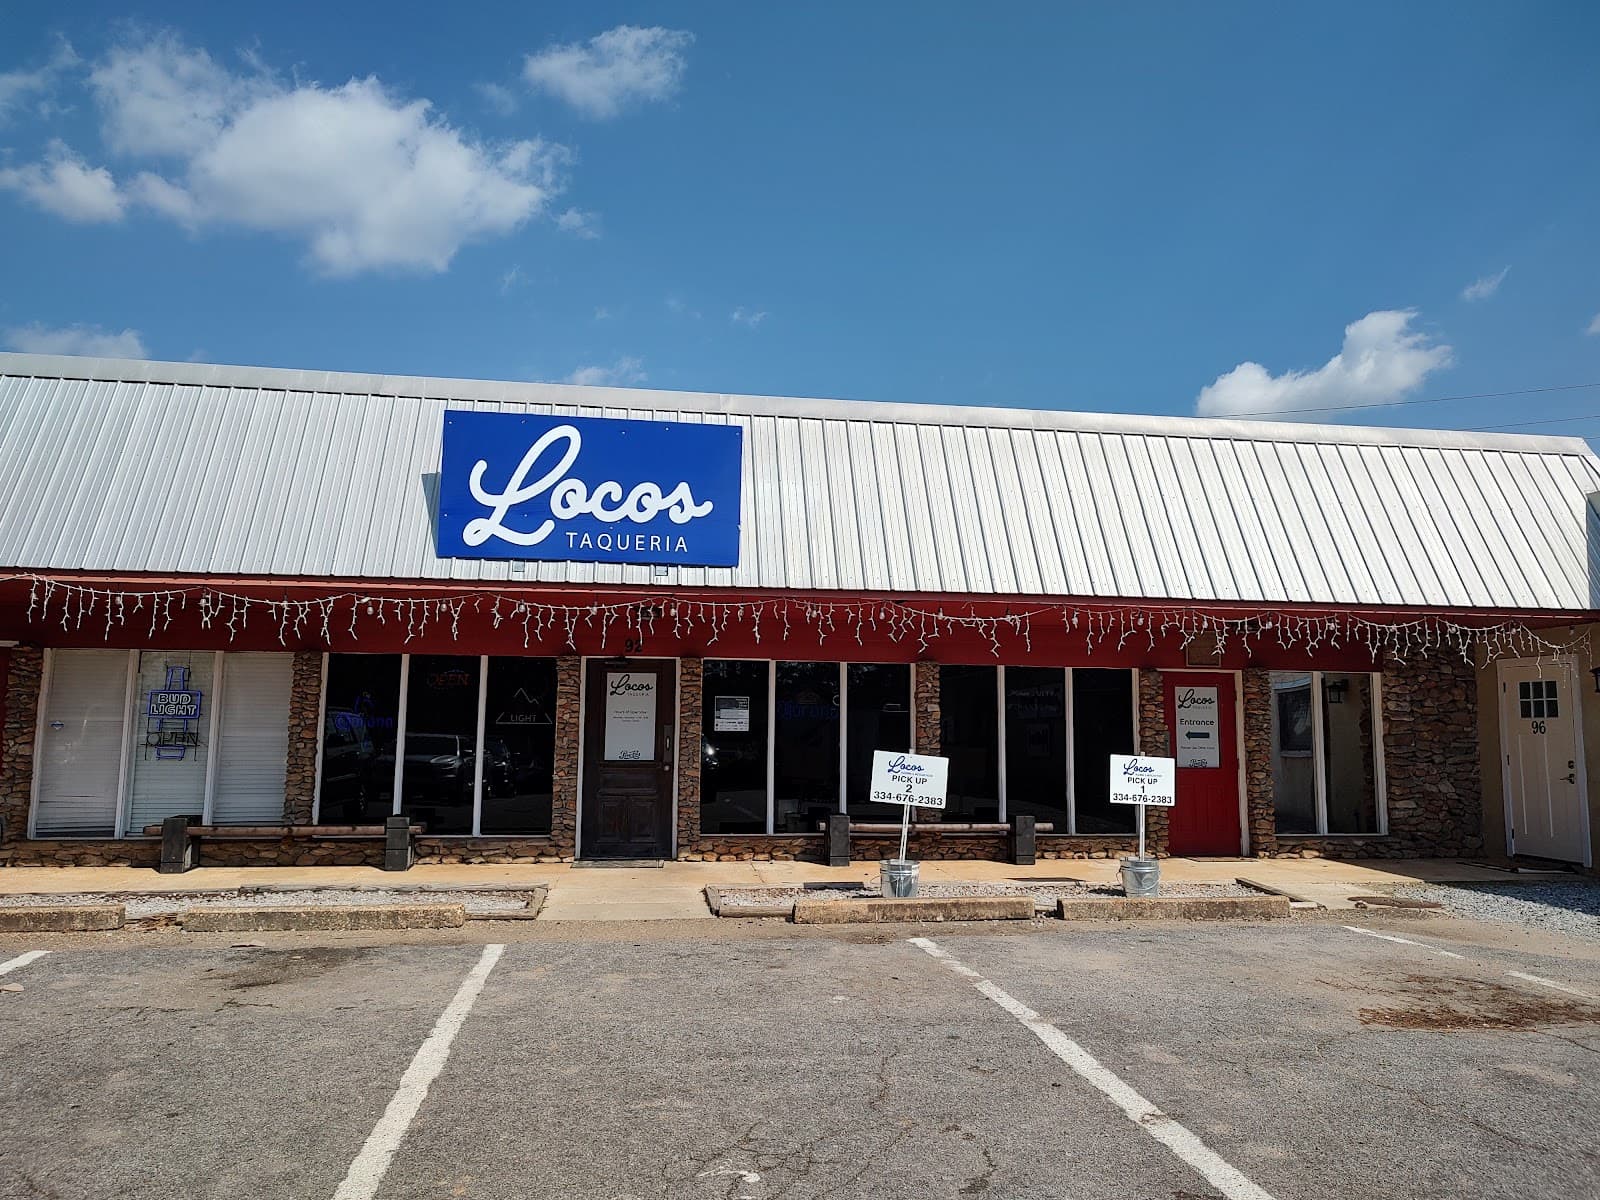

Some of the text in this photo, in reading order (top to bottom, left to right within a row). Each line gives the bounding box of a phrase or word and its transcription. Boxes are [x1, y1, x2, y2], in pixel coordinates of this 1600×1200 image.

[462, 425, 713, 547] Locos
[565, 531, 688, 553] TAQUERIA
[625, 638, 643, 653] 92
[610, 674, 653, 696] Locos
[157, 693, 191, 704] BUD
[1178, 688, 1215, 709] Locos
[150, 704, 196, 716] LIGHT
[511, 714, 537, 723] LIGHT
[1179, 718, 1215, 726] Entrance
[1532, 720, 1546, 734] 96
[888, 756, 924, 773] Locos
[1123, 758, 1155, 775] Locos
[892, 774, 913, 784] PICK
[915, 777, 928, 785] UP
[1127, 776, 1146, 785] PICK
[905, 784, 913, 793] 2
[1140, 786, 1144, 794] 1
[873, 791, 943, 806] 334-676-2383
[1112, 793, 1172, 804] 334-676-2383
